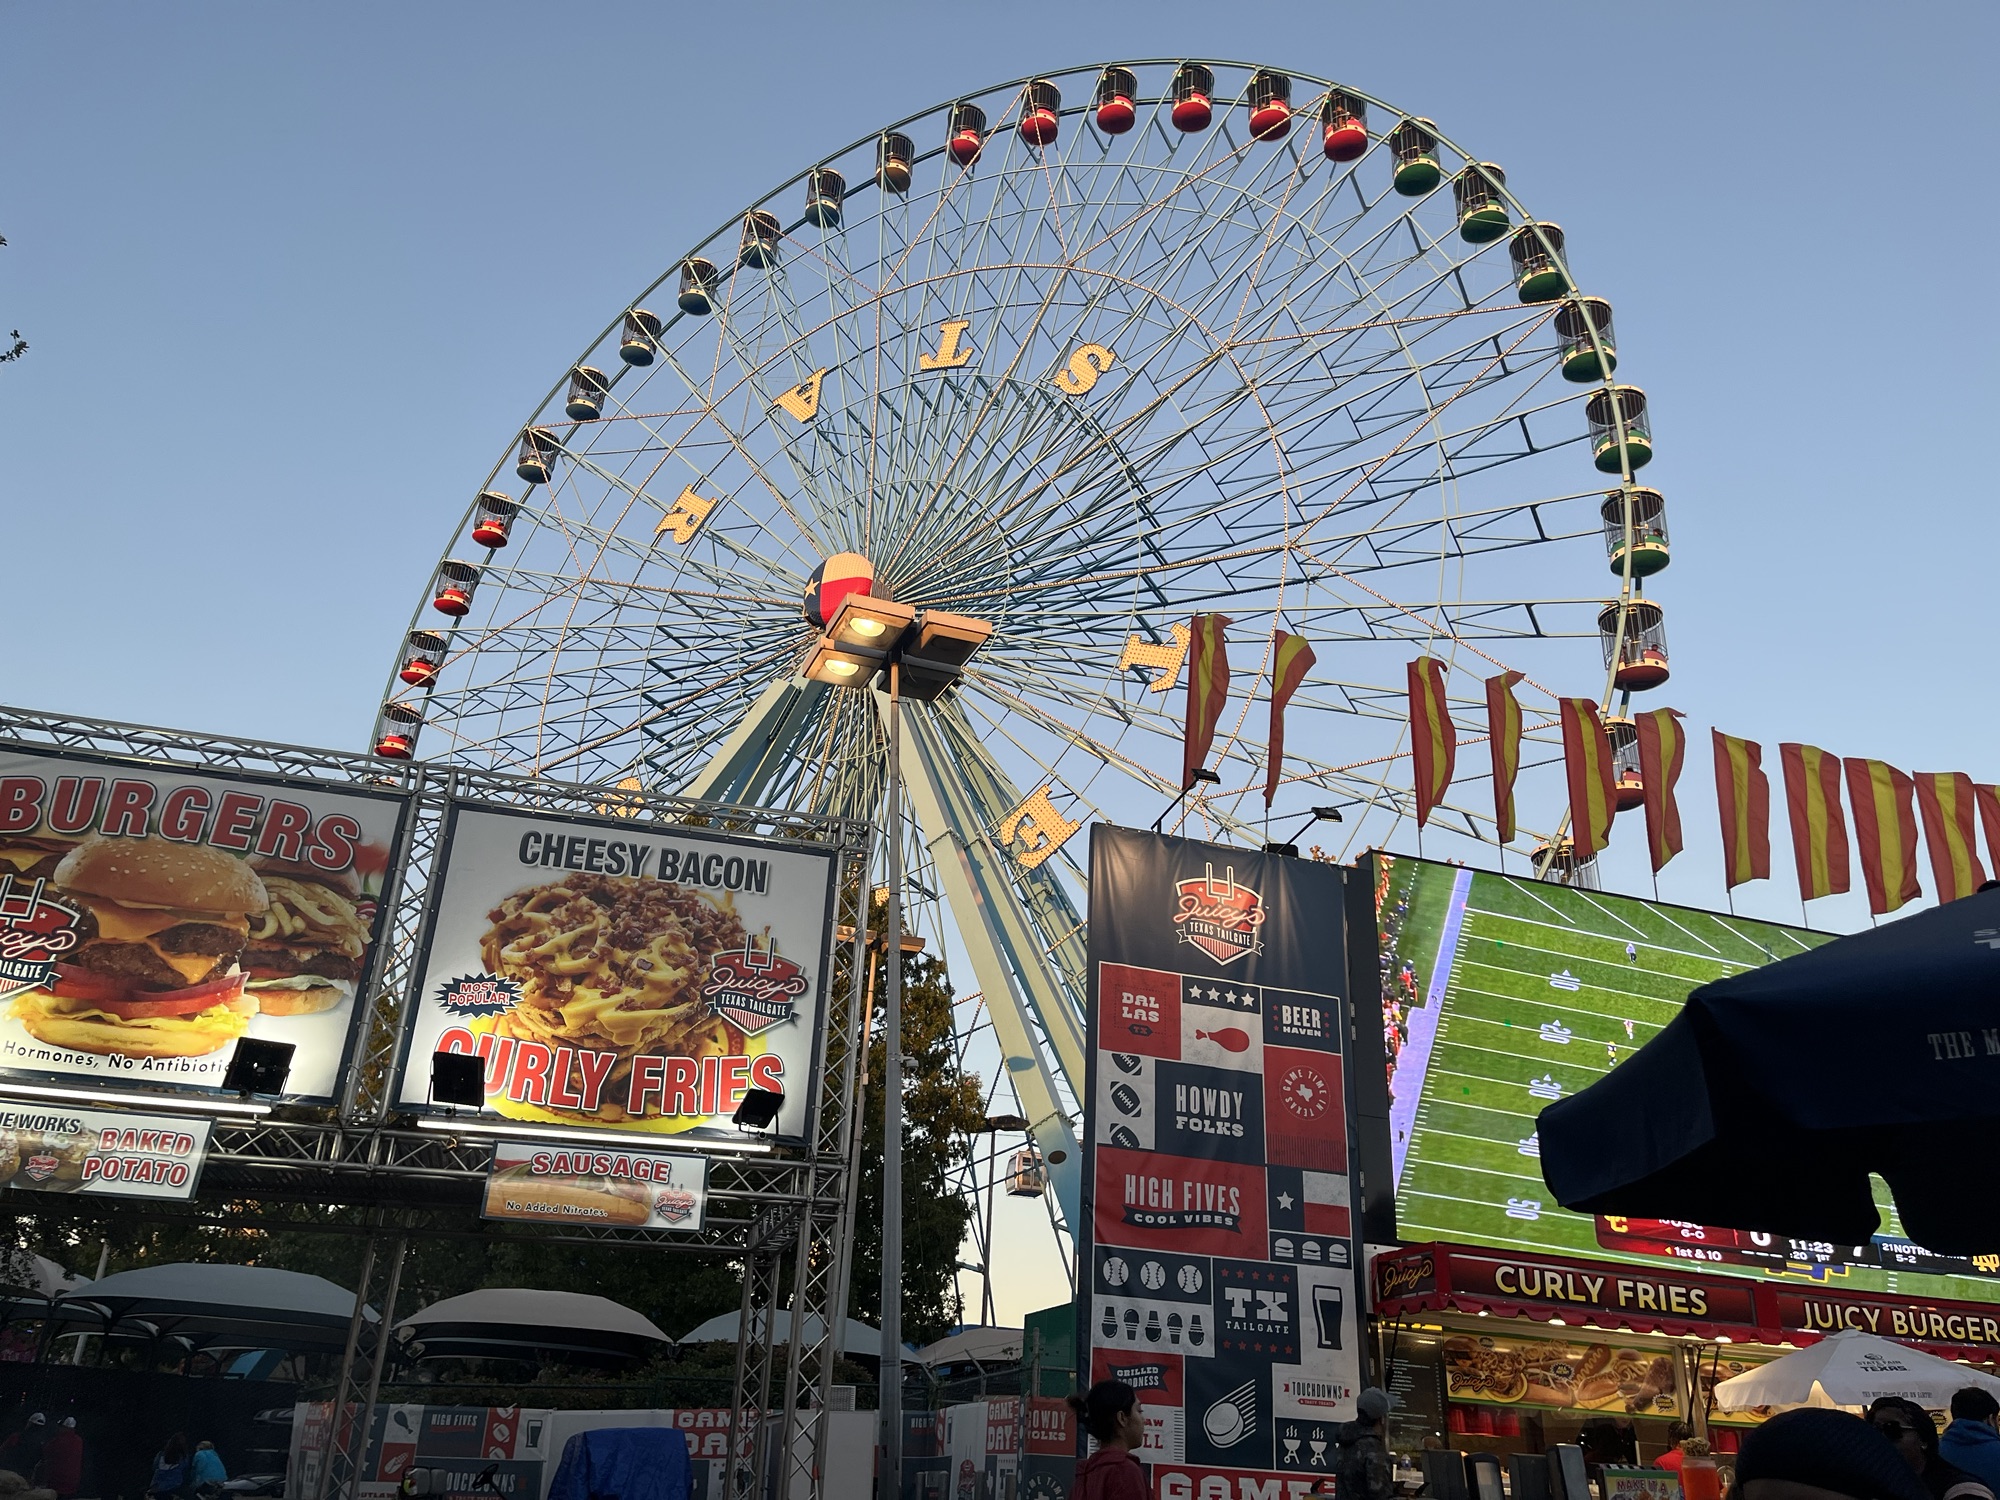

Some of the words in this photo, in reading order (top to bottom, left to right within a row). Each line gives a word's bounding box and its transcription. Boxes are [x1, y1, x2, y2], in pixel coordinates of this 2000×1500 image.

[0, 776, 361, 871] BURGERS
[519, 830, 652, 878] CHEESY
[657, 848, 769, 893] BACON
[1173, 895, 1266, 928] Juicys
[1189, 921, 1214, 936] TEXAS
[1216, 927, 1251, 946] TAILGATE
[460, 982, 497, 993] MOST
[704, 967, 806, 999] Juicys
[448, 992, 510, 1005] POPULAR!
[721, 994, 747, 1008] TEXAS
[749, 998, 787, 1016] TAILGATE
[1121, 991, 1160, 1009] DAL
[1121, 1006, 1160, 1023] LAS
[1282, 1005, 1322, 1028] BEER
[1133, 1026, 1148, 1035] TX
[1282, 1026, 1322, 1037] HAVEN
[4, 1040, 99, 1069] Hormones,
[107, 1054, 134, 1070] No
[1927, 1031, 1975, 1060] THE
[1282, 1069, 1303, 1092] GAME
[1307, 1070, 1327, 1094] TIME
[1175, 1083, 1244, 1121] HOWDY
[1285, 1096, 1315, 1117] TEXAS
[1316, 1099, 1327, 1112] IN
[18, 1113, 81, 1134] WORKS
[1175, 1115, 1245, 1138] FOLKS
[99, 1128, 194, 1158] BAKED
[81, 1156, 189, 1187] POTATO
[531, 1152, 671, 1184] SAUSAGE
[1125, 1174, 1173, 1209] HIGH
[1183, 1181, 1240, 1216] FIVES
[506, 1201, 521, 1211] No
[525, 1203, 559, 1214] Added
[562, 1205, 609, 1218] Nitrates.
[1134, 1213, 1177, 1225] COOL
[1184, 1214, 1234, 1226] VIBES
[1681, 1229, 1705, 1239] 6-0
[1674, 1246, 1693, 1258] 1st
[1694, 1249, 1705, 1259] &
[1707, 1250, 1722, 1261] 10
[1788, 1238, 1834, 1254] 11:23
[1895, 1254, 1917, 1263] 5-2
[1384, 1259, 1433, 1296] Juicys
[1495, 1266, 1604, 1303] CURLY
[1617, 1279, 1707, 1316] FRIES
[1224, 1286, 1289, 1323] TX
[1225, 1320, 1290, 1335] TAILGATE
[1803, 1302, 1881, 1333] JUICY
[1116, 1366, 1159, 1377] GRILLED
[1292, 1381, 1342, 1399] TOUCHDOWNS
[1450, 1372, 1496, 1393] Juicys
[431, 1413, 450, 1426] HIGH
[454, 1414, 478, 1427] FIVES
[988, 1401, 1013, 1420] GAME
[987, 1425, 1012, 1451] DAY
[1617, 1480, 1646, 1491] MAKE
